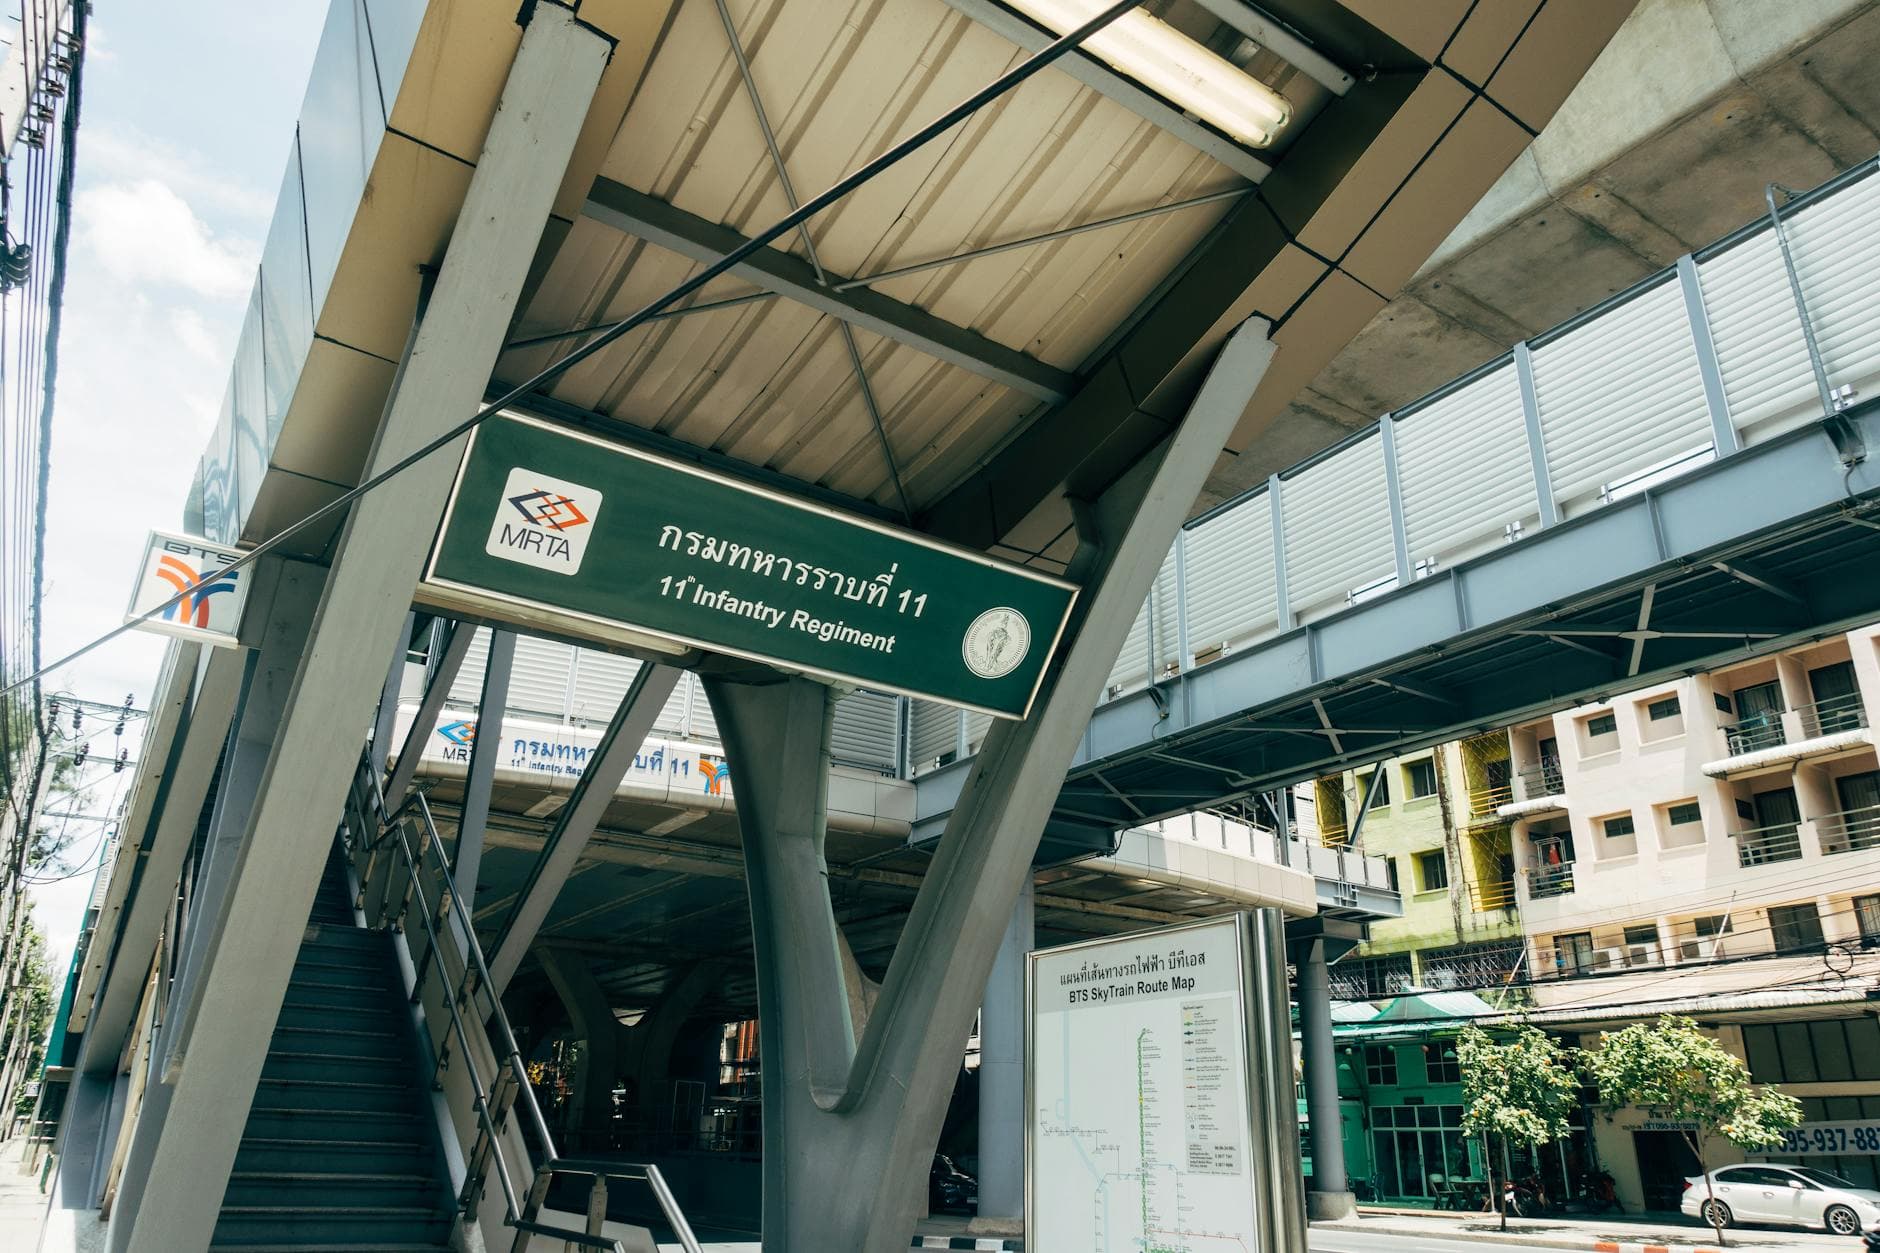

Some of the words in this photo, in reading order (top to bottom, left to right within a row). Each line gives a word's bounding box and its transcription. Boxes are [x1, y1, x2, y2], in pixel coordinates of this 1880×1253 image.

[164, 541, 241, 565] BTS
[499, 523, 570, 561] MRTA
[658, 524, 898, 607] กรมทหารราบที่
[897, 588, 928, 618] 11
[692, 583, 786, 629] Infantry
[789, 609, 896, 654] Regiment
[443, 747, 472, 761] MR
[671, 758, 688, 775] 11
[1060, 954, 1165, 986] แผนที่เส้นทางรถไฟฟ้า
[1168, 950, 1206, 970] บีทีเอส
[1069, 989, 1089, 1003] BTS
[1091, 984, 1134, 1002] SkyTrain
[1137, 980, 1169, 995] Route
[1172, 976, 1195, 992] Map
